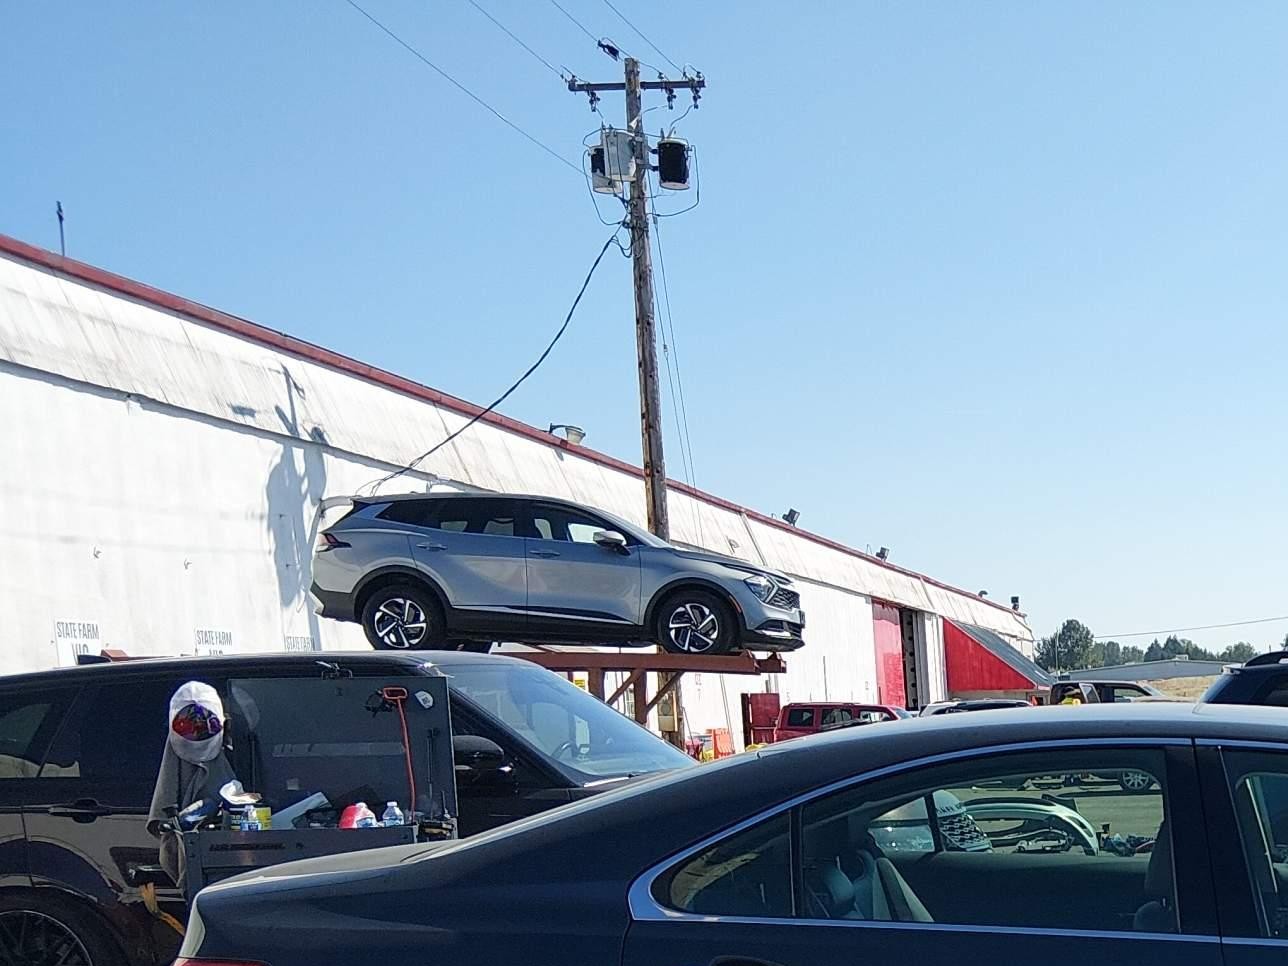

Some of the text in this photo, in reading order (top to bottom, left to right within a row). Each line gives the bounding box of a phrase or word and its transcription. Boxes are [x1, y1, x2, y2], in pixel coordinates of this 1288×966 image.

[57, 621, 100, 640] STATE FARM
[196, 630, 232, 647] STATE FARM
